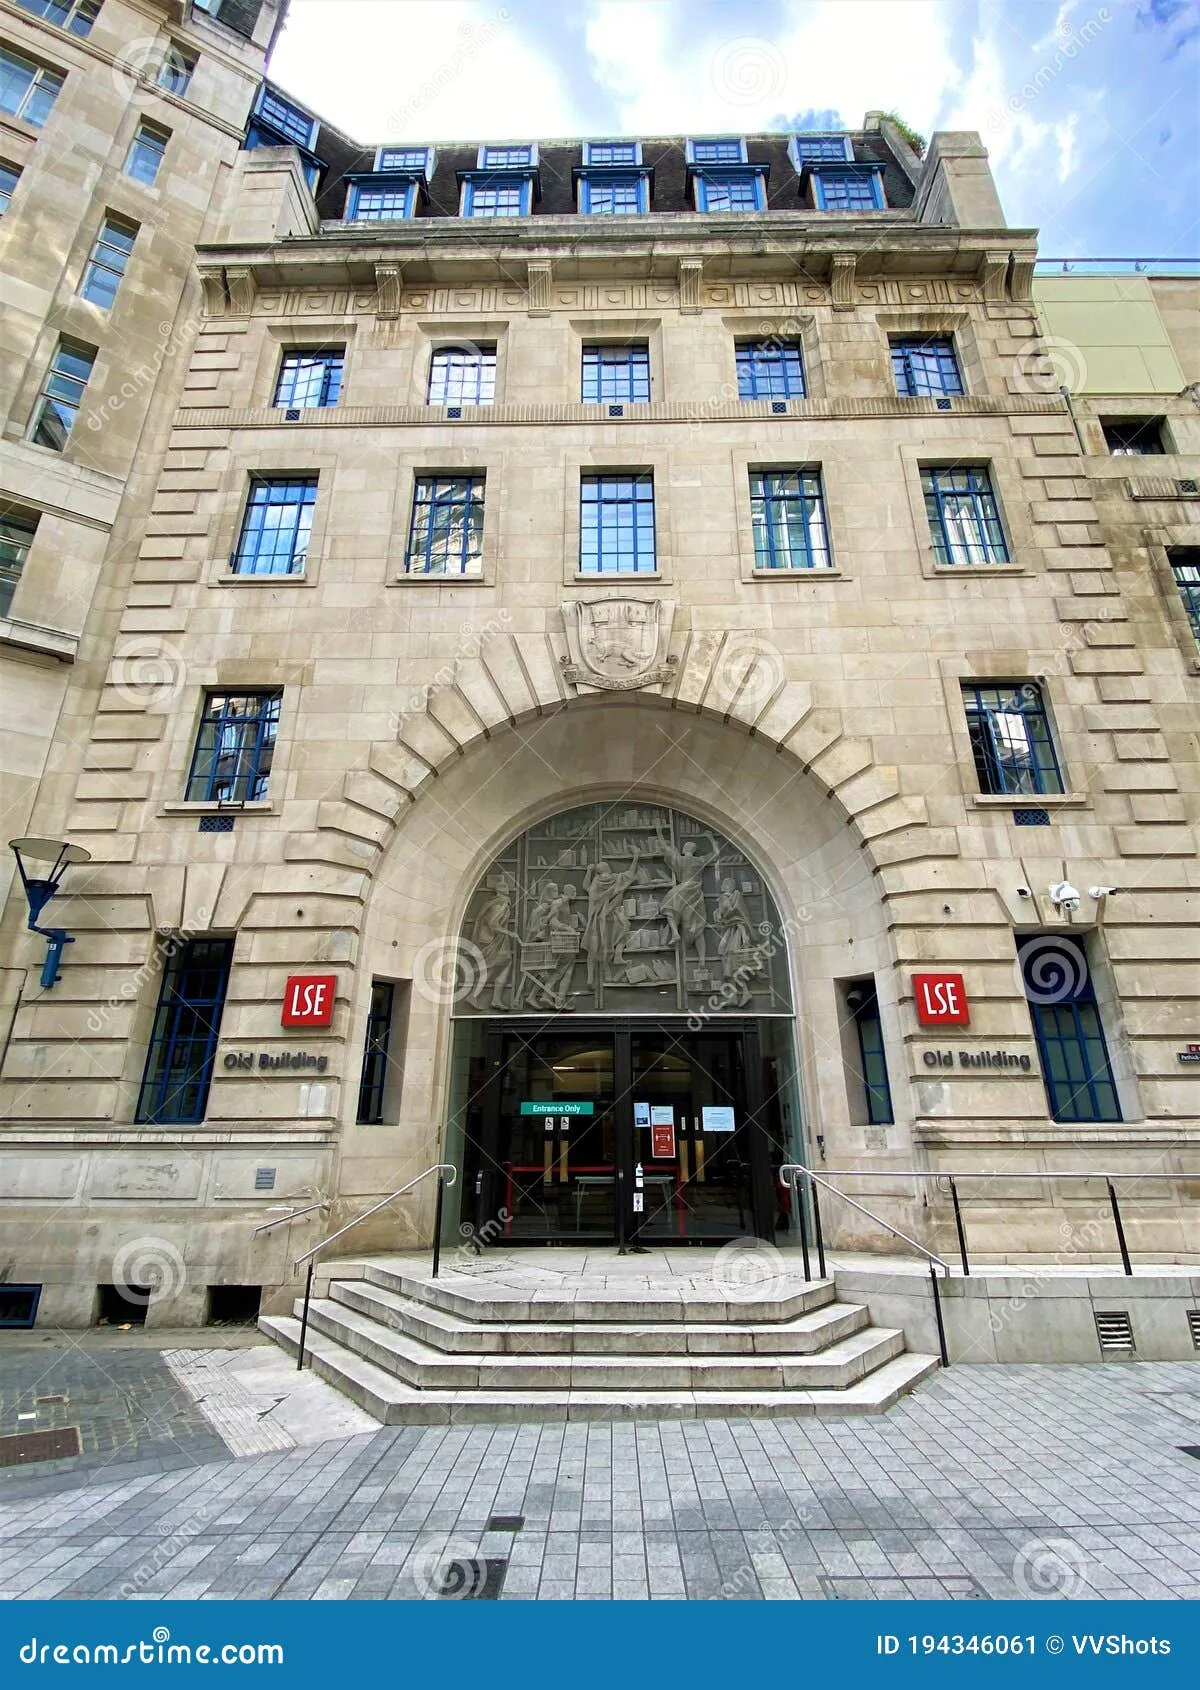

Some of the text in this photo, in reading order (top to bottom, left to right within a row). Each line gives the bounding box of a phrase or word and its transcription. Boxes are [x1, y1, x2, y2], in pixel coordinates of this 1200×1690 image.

[291, 984, 327, 1016] LSE
[923, 982, 960, 1015] LSE
[223, 1051, 328, 1073] Old Building
[923, 1050, 1031, 1072] Old Building
[532, 1104, 581, 1114] Entrance Only
